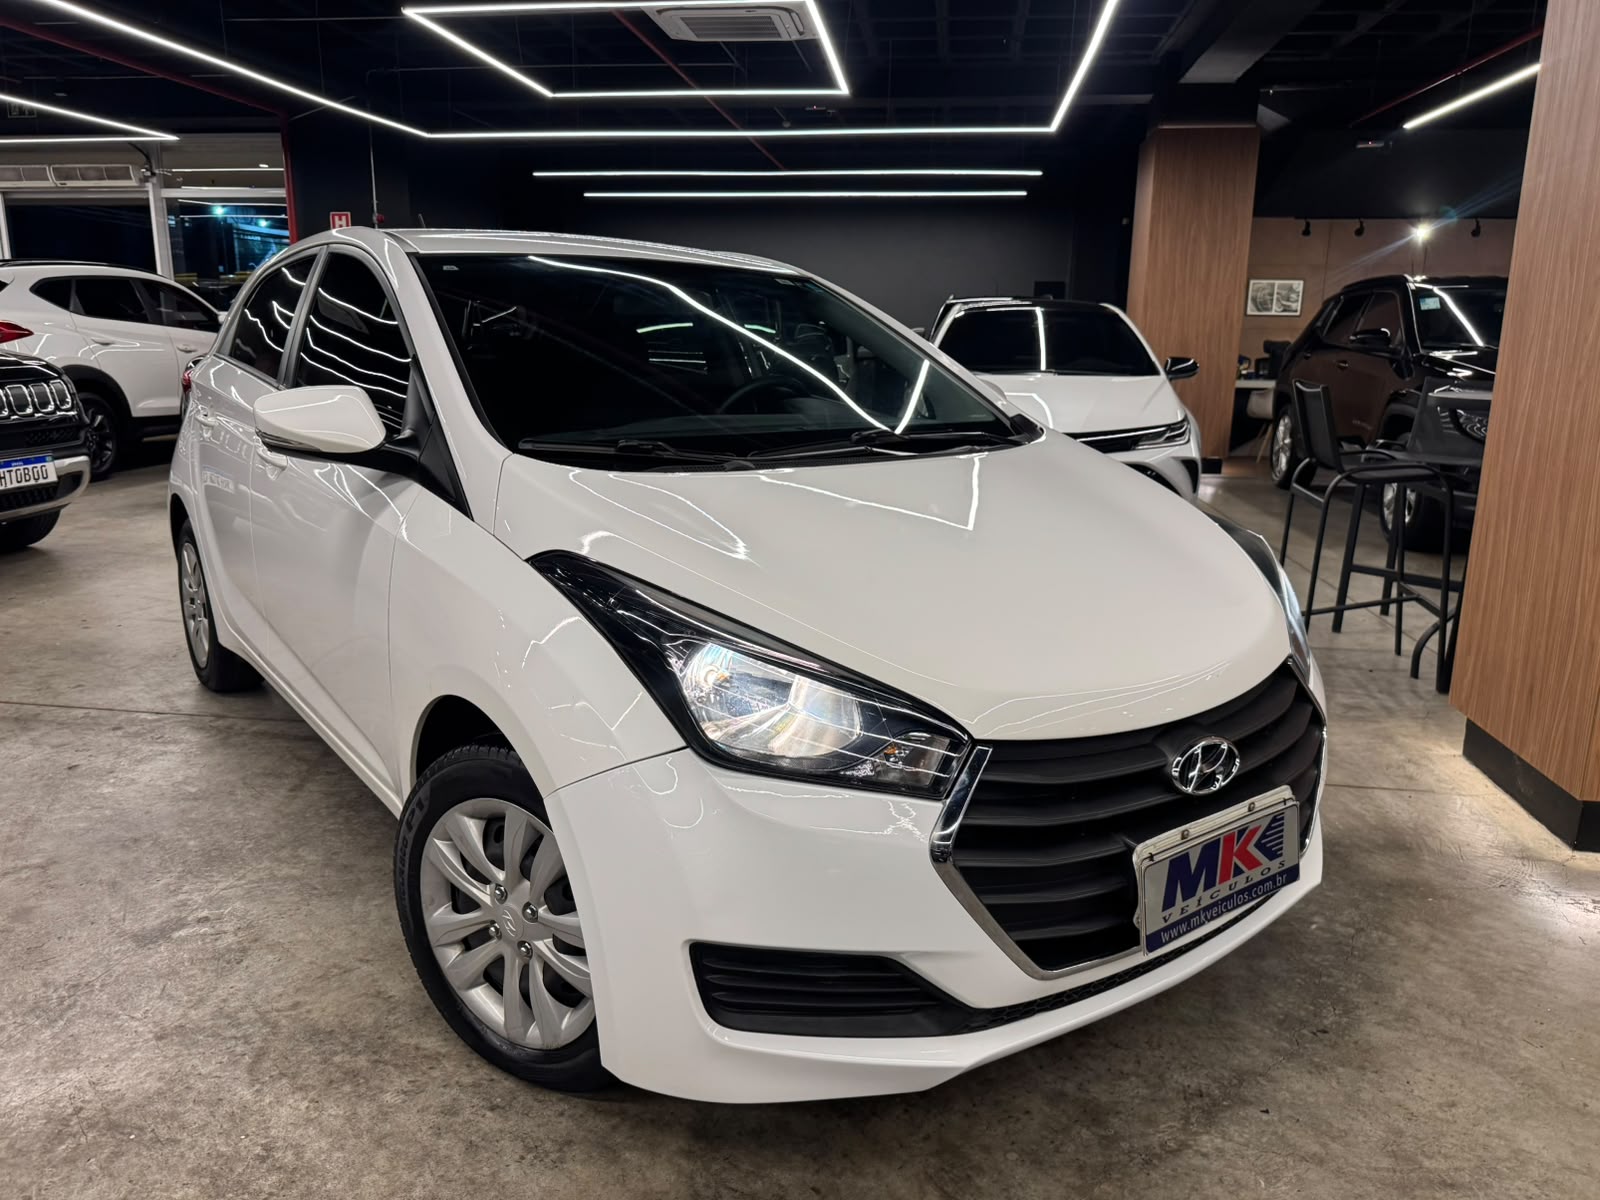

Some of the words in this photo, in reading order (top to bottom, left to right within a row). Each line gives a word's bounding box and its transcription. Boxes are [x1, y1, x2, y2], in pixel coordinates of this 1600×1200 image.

[334, 215, 347, 228] H
[1161, 824, 1264, 914] MK
[1162, 859, 1286, 924] VEICULOS
[1160, 873, 1288, 944] www.mkveiculos.com.br
